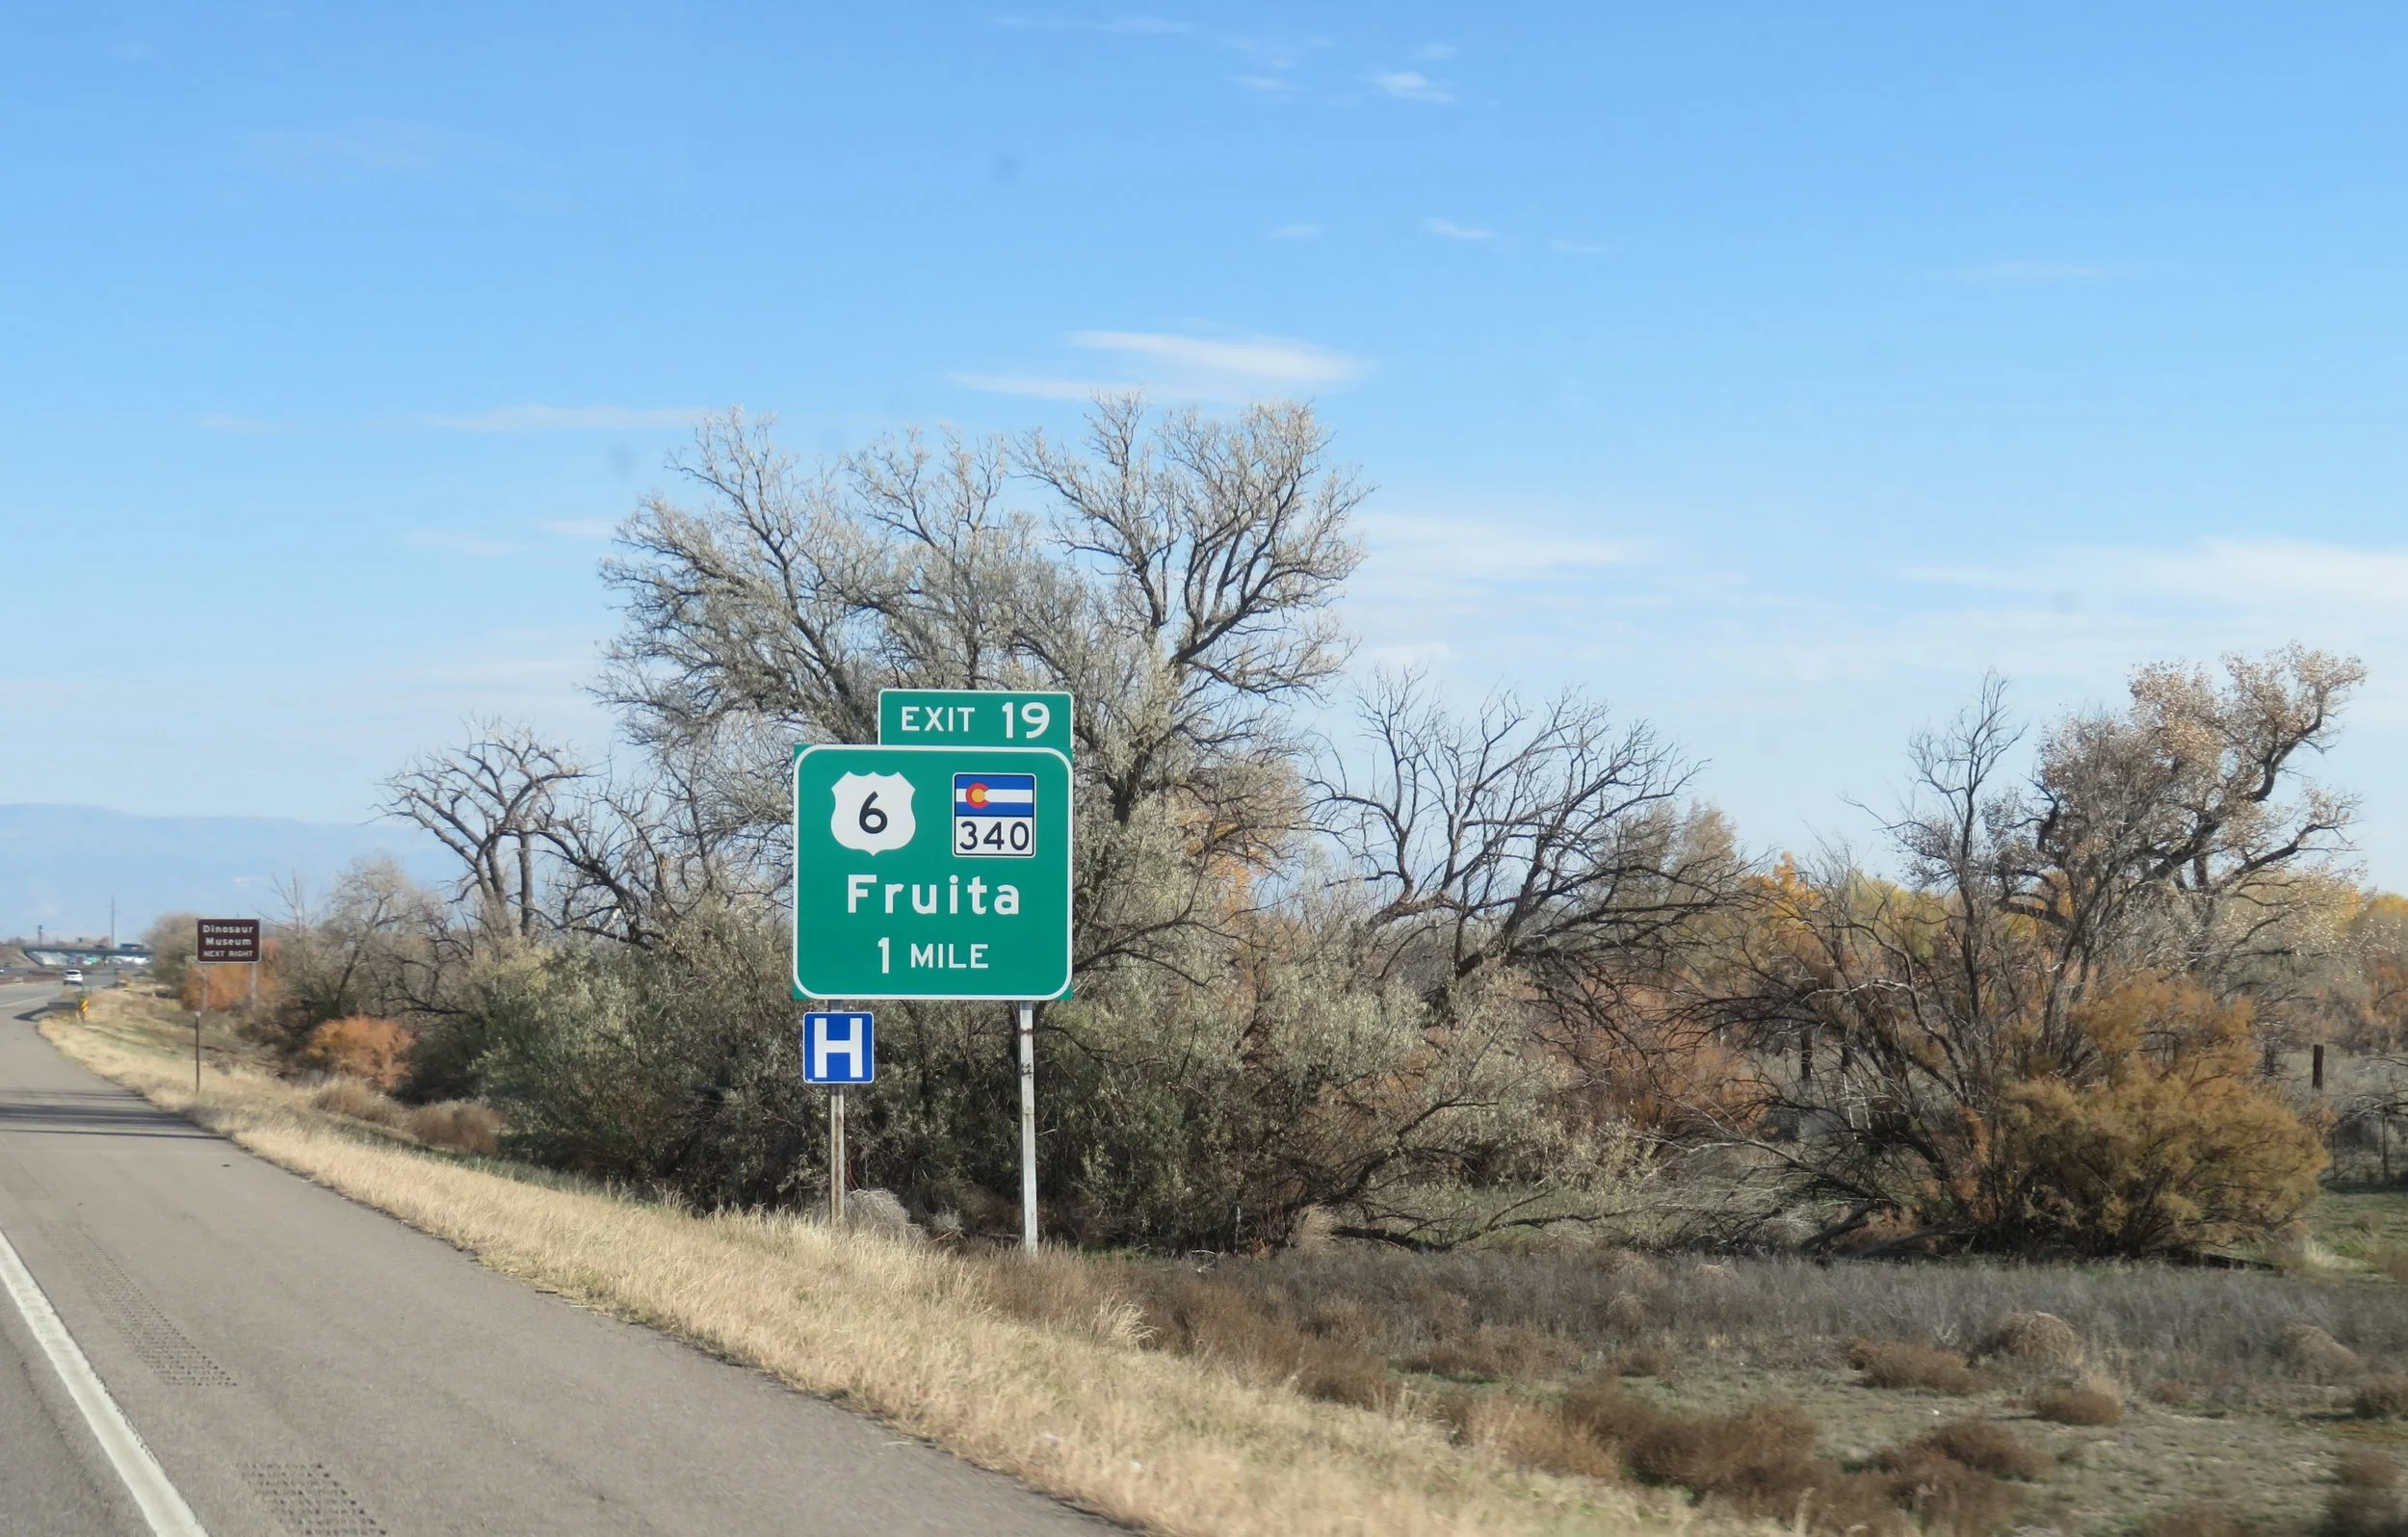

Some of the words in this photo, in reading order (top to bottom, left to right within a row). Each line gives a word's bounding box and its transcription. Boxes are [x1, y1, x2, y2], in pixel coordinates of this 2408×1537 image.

[902, 706, 975, 732] EXIT
[1002, 702, 1050, 739] 19
[858, 791, 888, 834] 6
[959, 821, 1029, 850] 340
[848, 874, 1019, 915] Fruita
[203, 925, 253, 933] Dinosaur
[205, 937, 251, 946] Museum
[877, 937, 890, 974] 1
[910, 943, 988, 969] MILE
[814, 1017, 863, 1079] H
